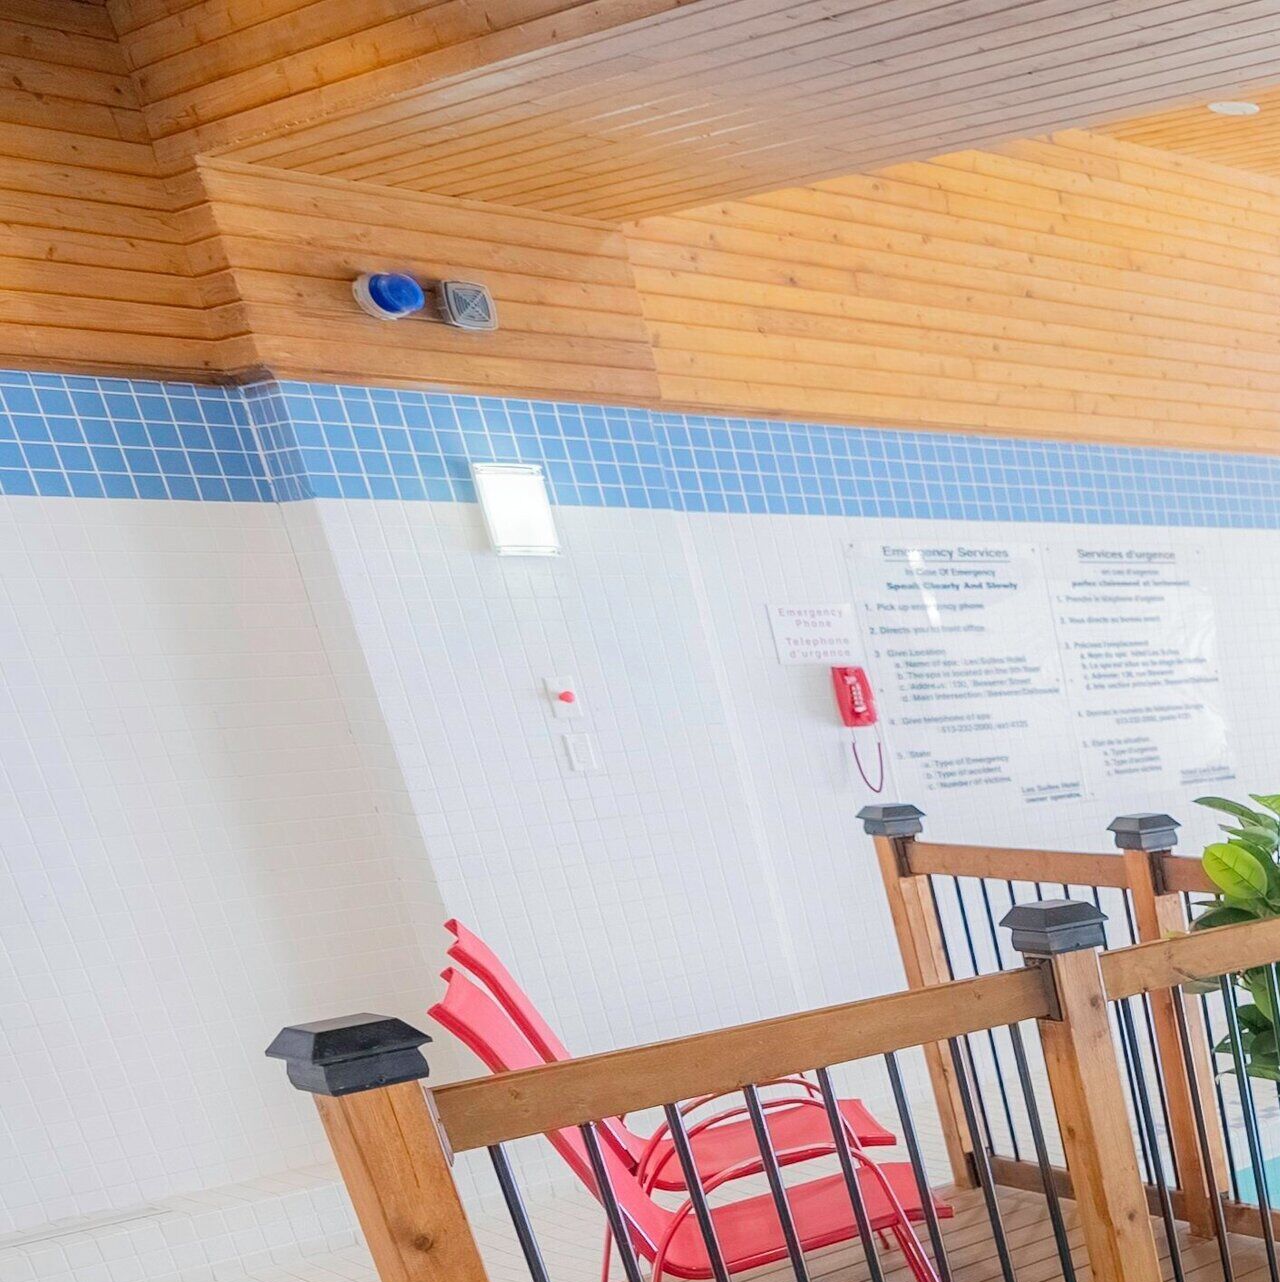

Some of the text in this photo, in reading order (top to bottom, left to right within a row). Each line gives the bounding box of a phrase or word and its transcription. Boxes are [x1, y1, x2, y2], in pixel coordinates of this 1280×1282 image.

[957, 546, 1010, 558] Services
[1077, 549, 1176, 562] Services d'urgence
[951, 568, 996, 578] Emergency
[886, 581, 1018, 591] Speak Clearly And Slowly
[877, 603, 896, 612] Pick
[898, 604, 909, 613] up
[959, 603, 985, 612] phone
[777, 608, 843, 619] Emergency
[795, 619, 832, 629] Phone
[879, 627, 911, 635] Directs
[913, 627, 929, 636] you
[786, 637, 851, 648] Telephone
[790, 650, 851, 660] d'urgence
[887, 649, 909, 658] Give
[909, 649, 947, 658] Location
[913, 694, 934, 702] Main
[902, 717, 922, 726] Give
[923, 715, 965, 724] telephone
[935, 760, 955, 769] Type
[966, 756, 1010, 765] Emergency
[937, 770, 957, 779] Type
[968, 766, 1002, 775] accident
[940, 781, 973, 789] Number
[984, 776, 1012, 785] victims
